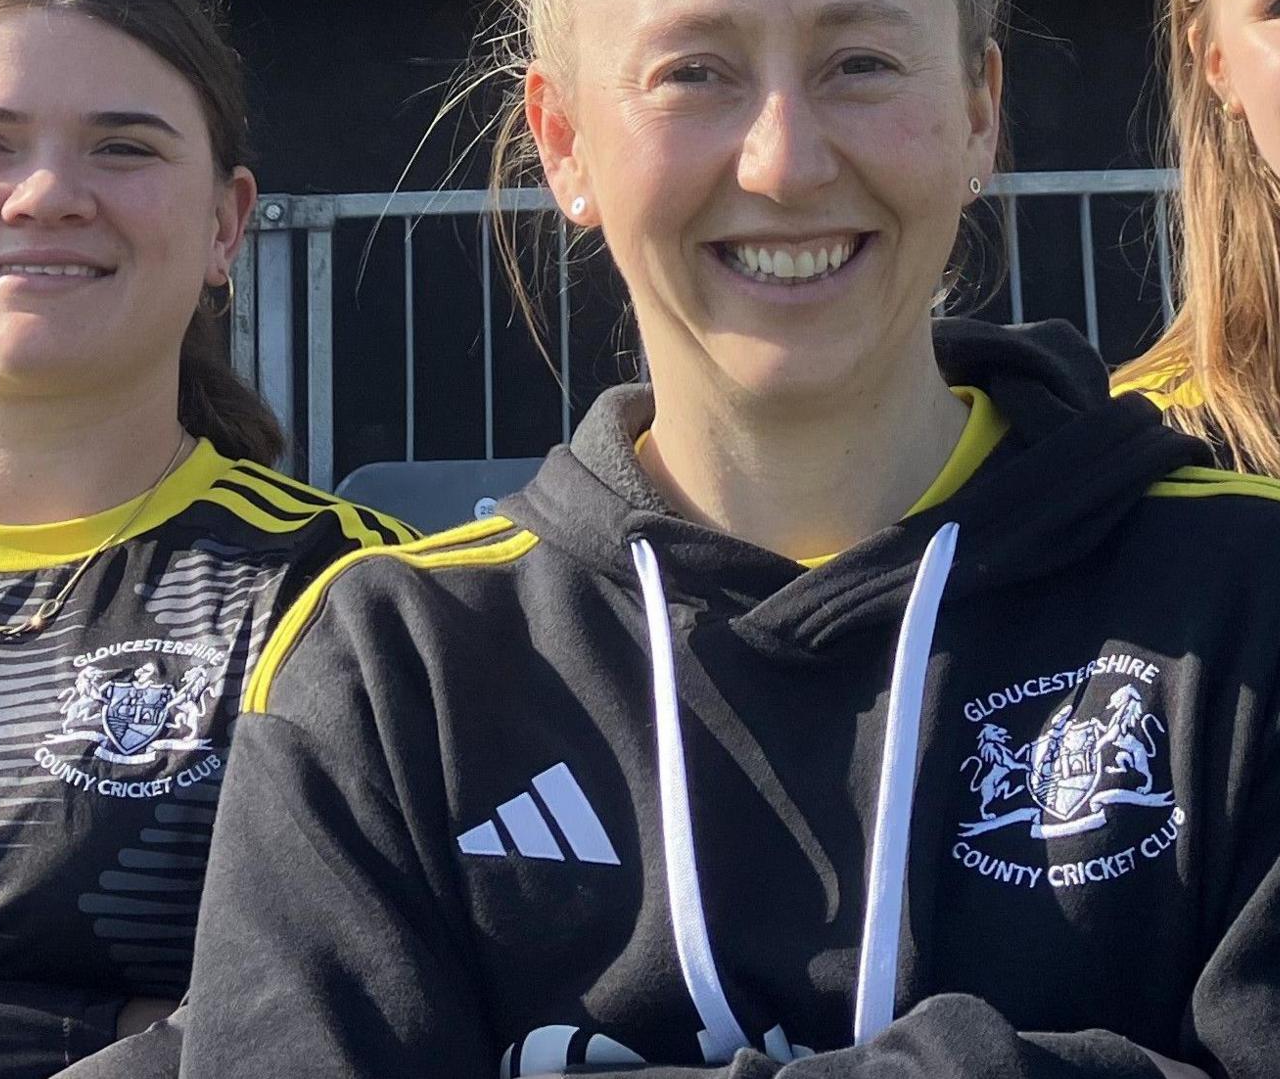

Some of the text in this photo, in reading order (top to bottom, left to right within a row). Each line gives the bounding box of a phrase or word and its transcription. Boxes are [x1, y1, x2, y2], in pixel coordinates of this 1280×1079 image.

[73, 638, 225, 668] GLOUCESTERSHIRE
[963, 653, 1160, 723] GLOUCESTERSHIRE
[34, 746, 222, 798] COUNTY CRICKET CLUB
[951, 806, 1186, 889] COUNTY CRICKET CLUB
